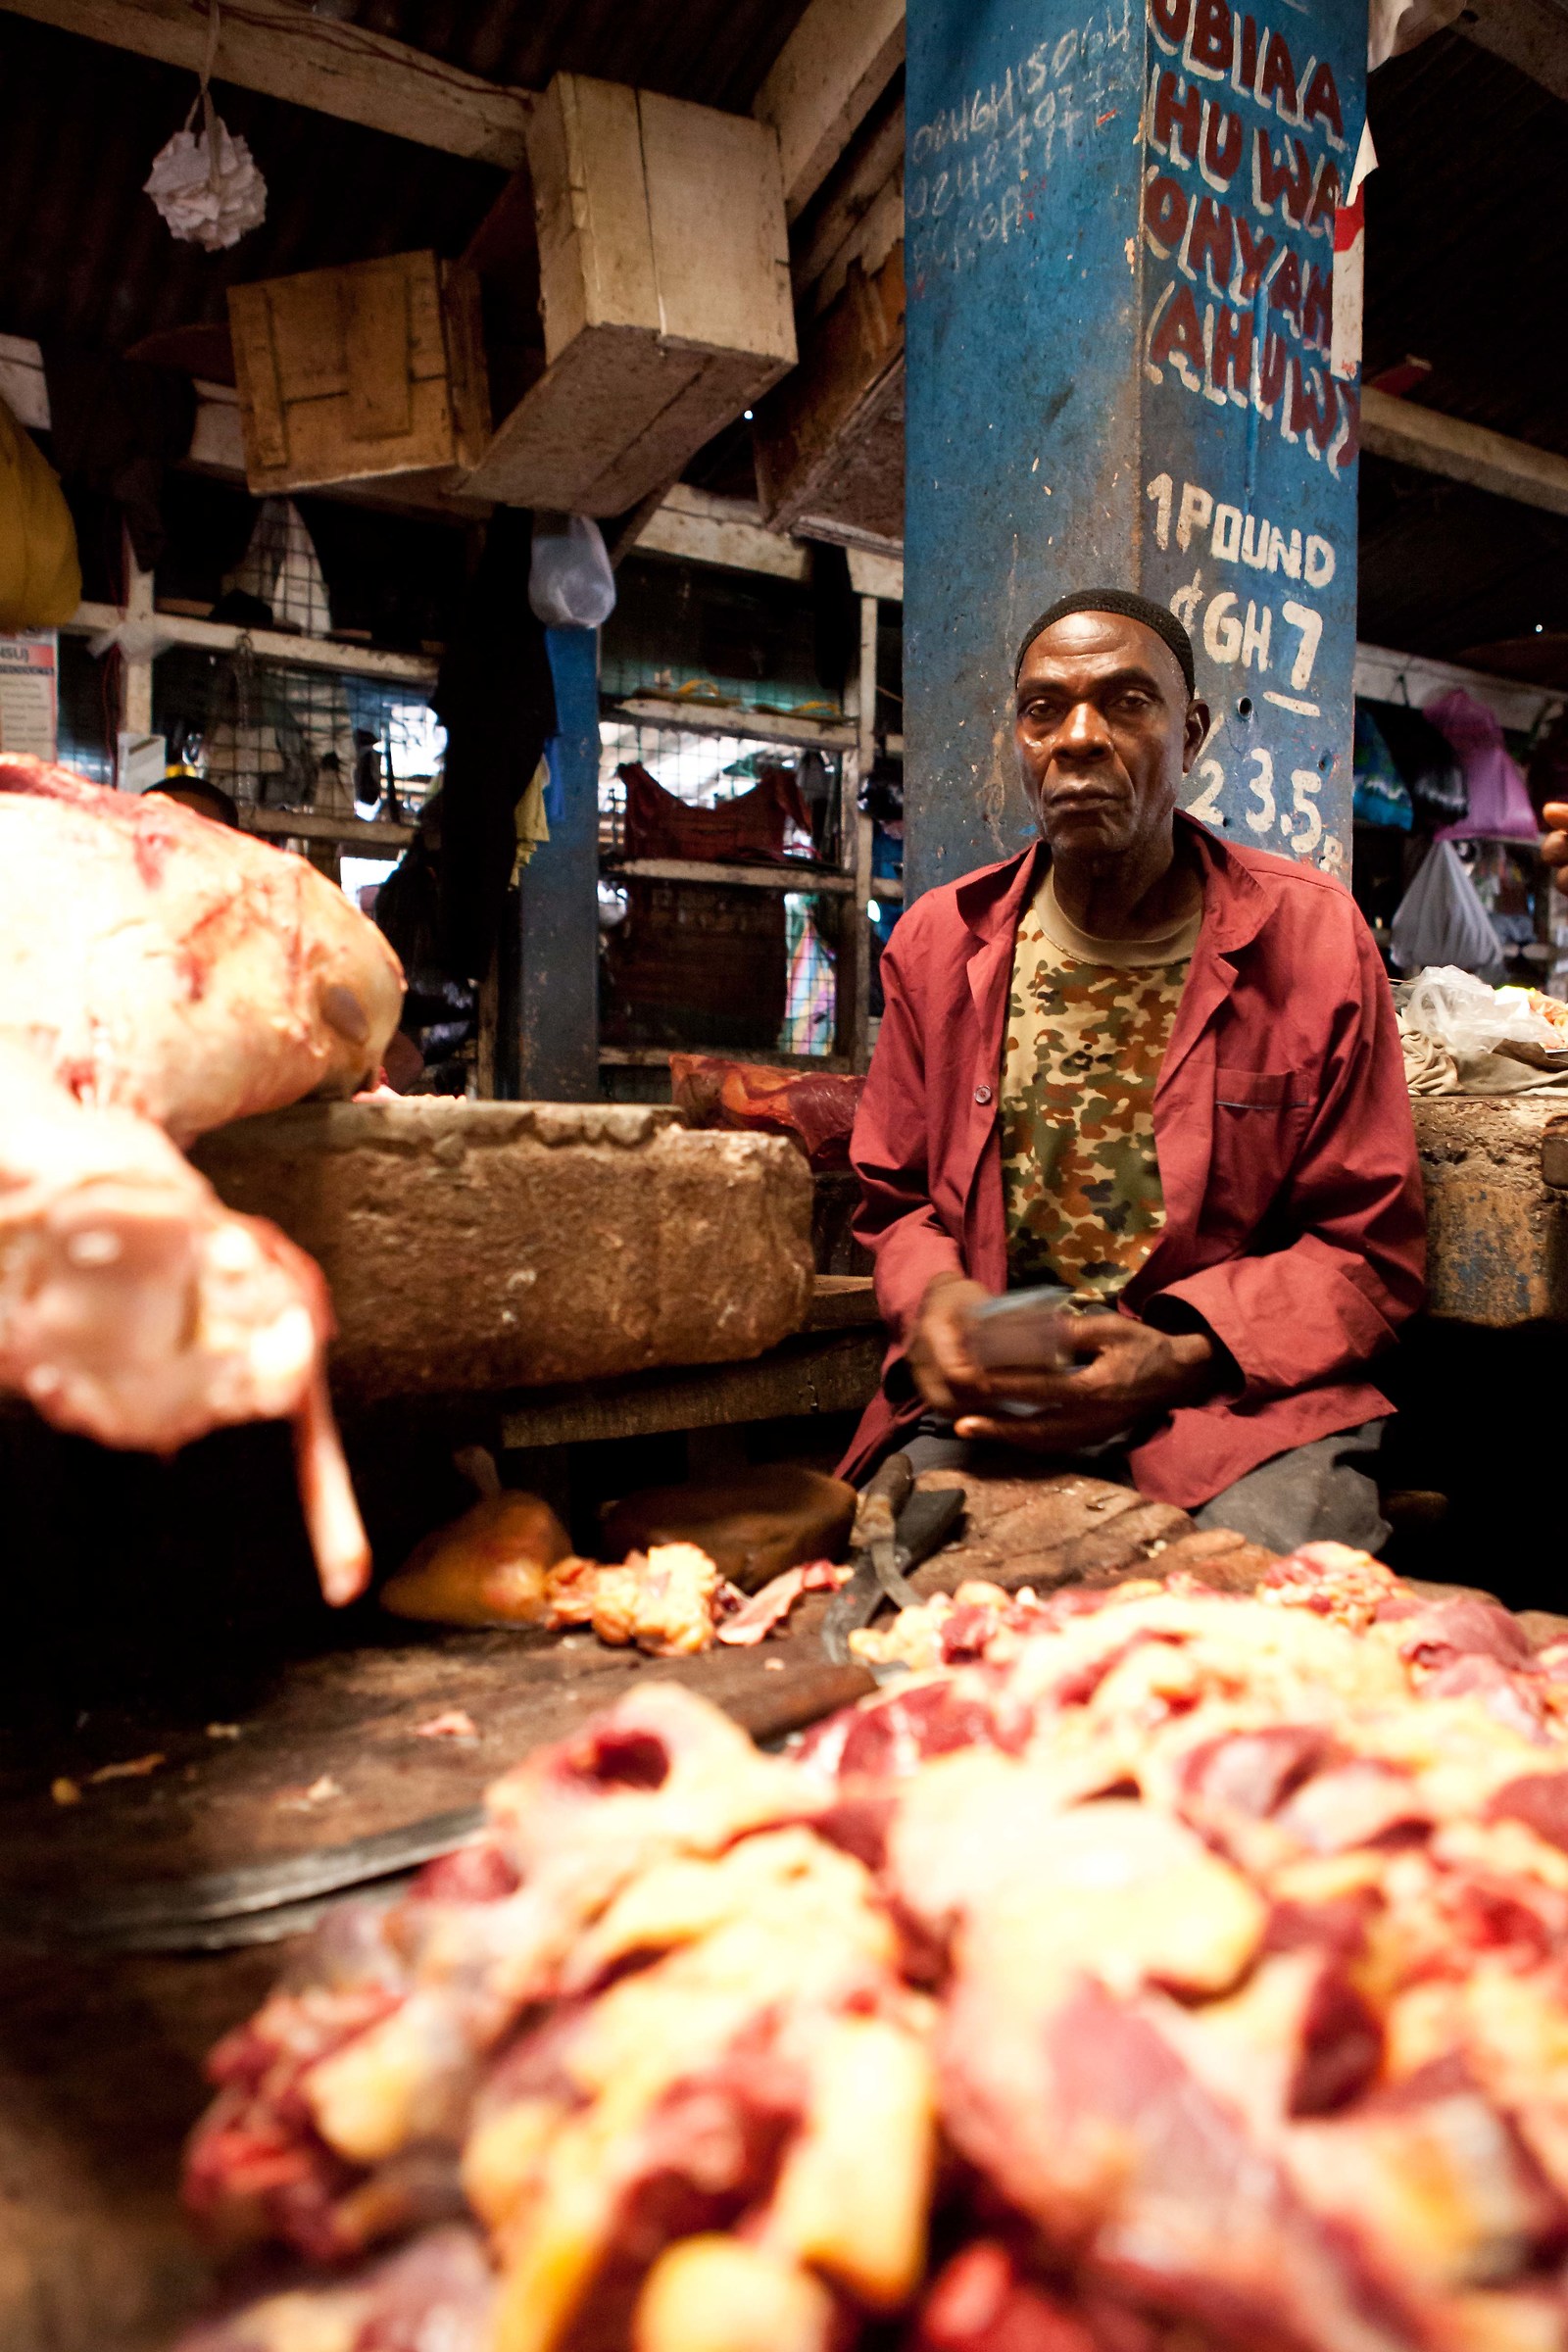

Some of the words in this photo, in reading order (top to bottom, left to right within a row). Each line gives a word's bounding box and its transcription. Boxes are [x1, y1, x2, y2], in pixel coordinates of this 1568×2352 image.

[1147, 471, 1173, 551] 1
[1177, 481, 1336, 588] POUND
[1282, 600, 1323, 691] 7
